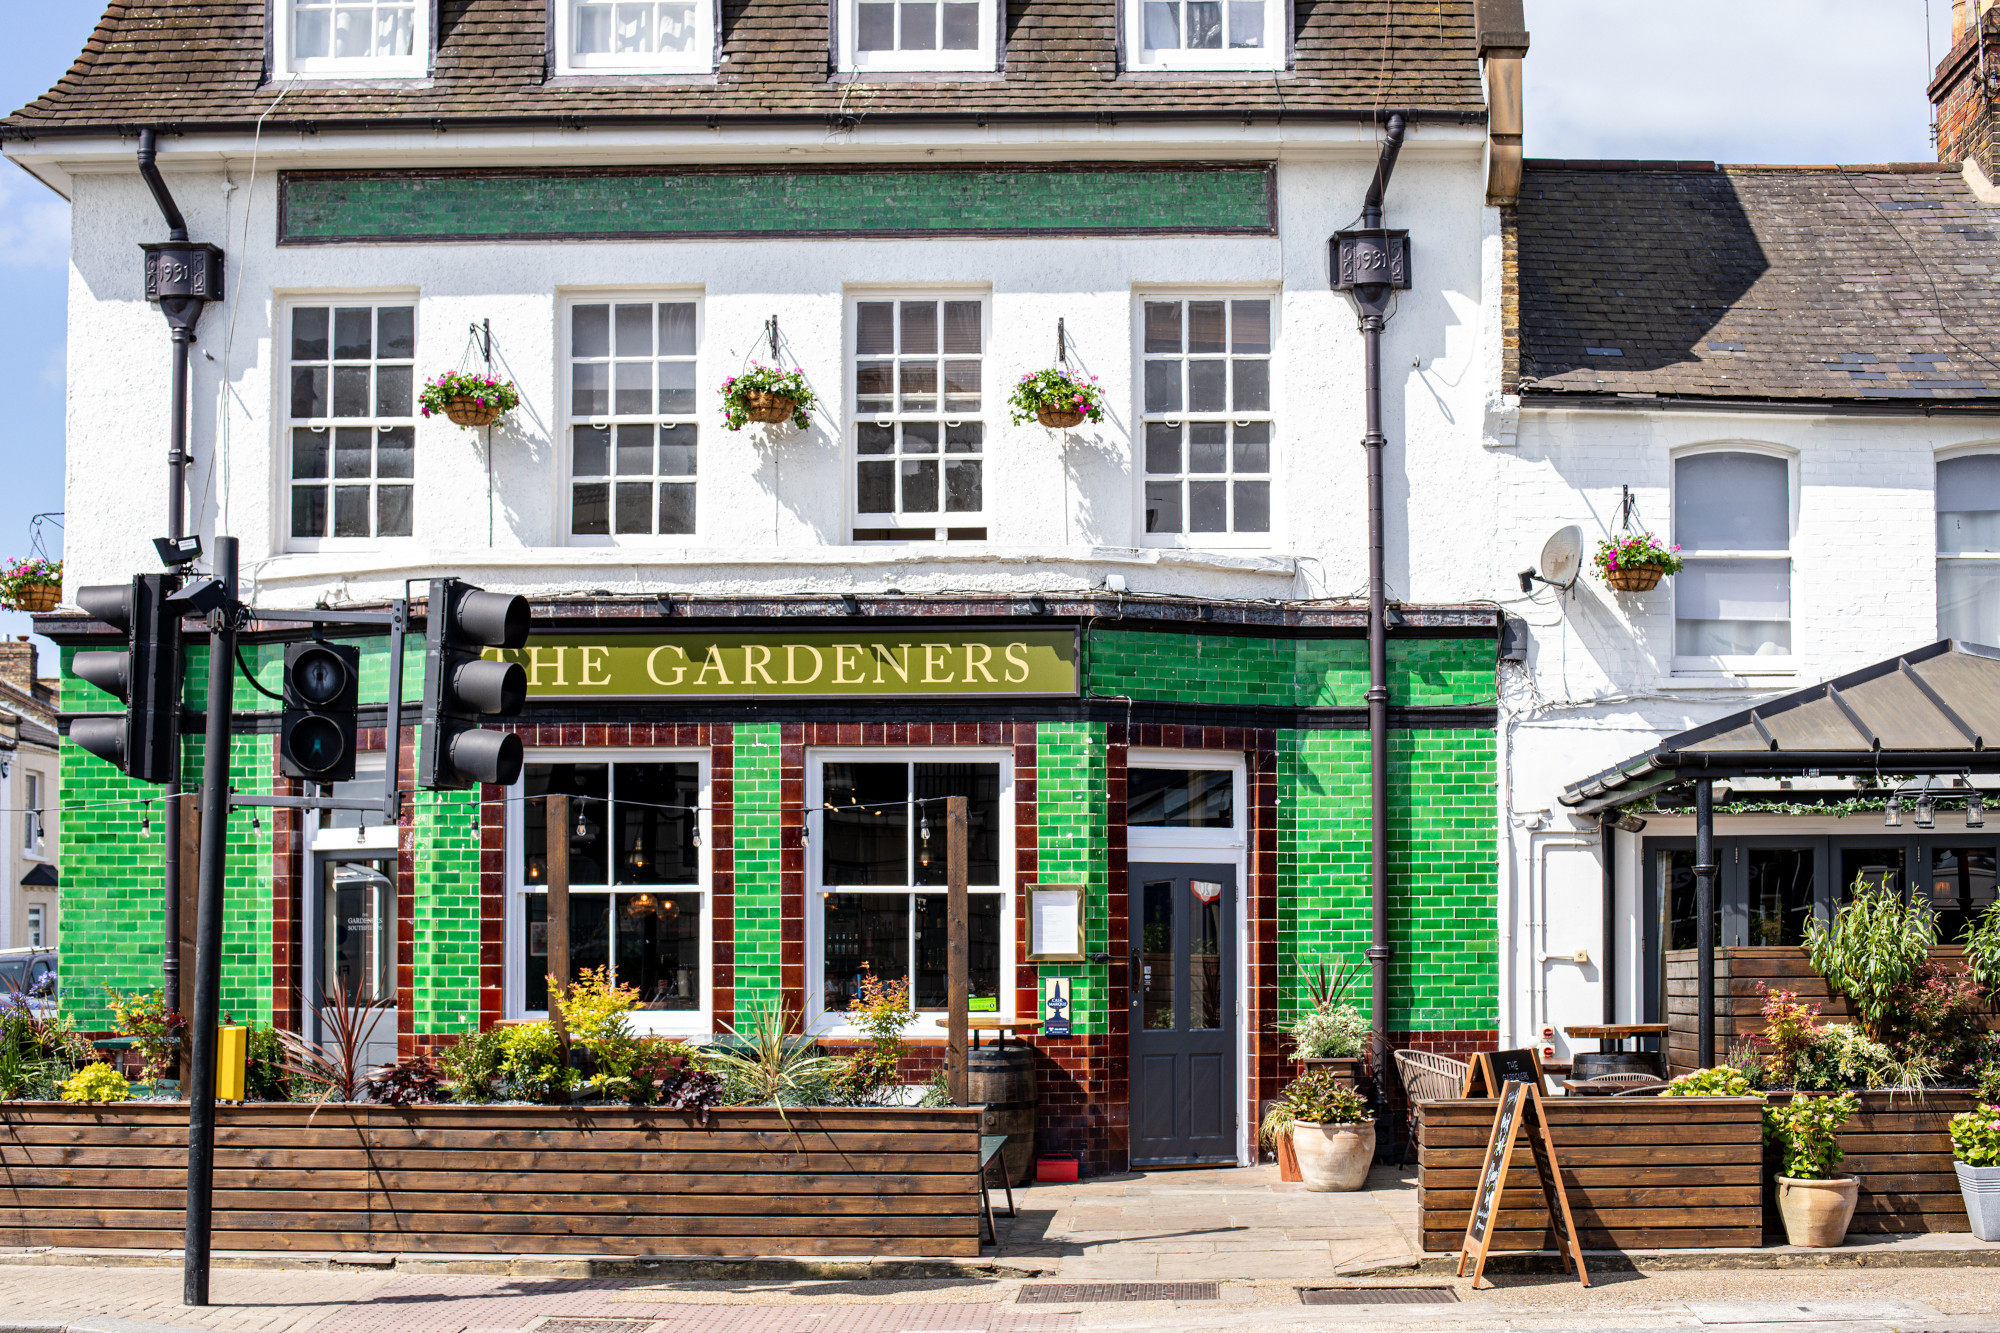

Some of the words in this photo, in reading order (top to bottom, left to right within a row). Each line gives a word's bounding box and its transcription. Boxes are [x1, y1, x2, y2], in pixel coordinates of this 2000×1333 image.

[1356, 249, 1387, 271] 1931
[159, 262, 188, 284] 1931
[646, 642, 1032, 686] GARDENERS
[1505, 1060, 1520, 1071] THE
